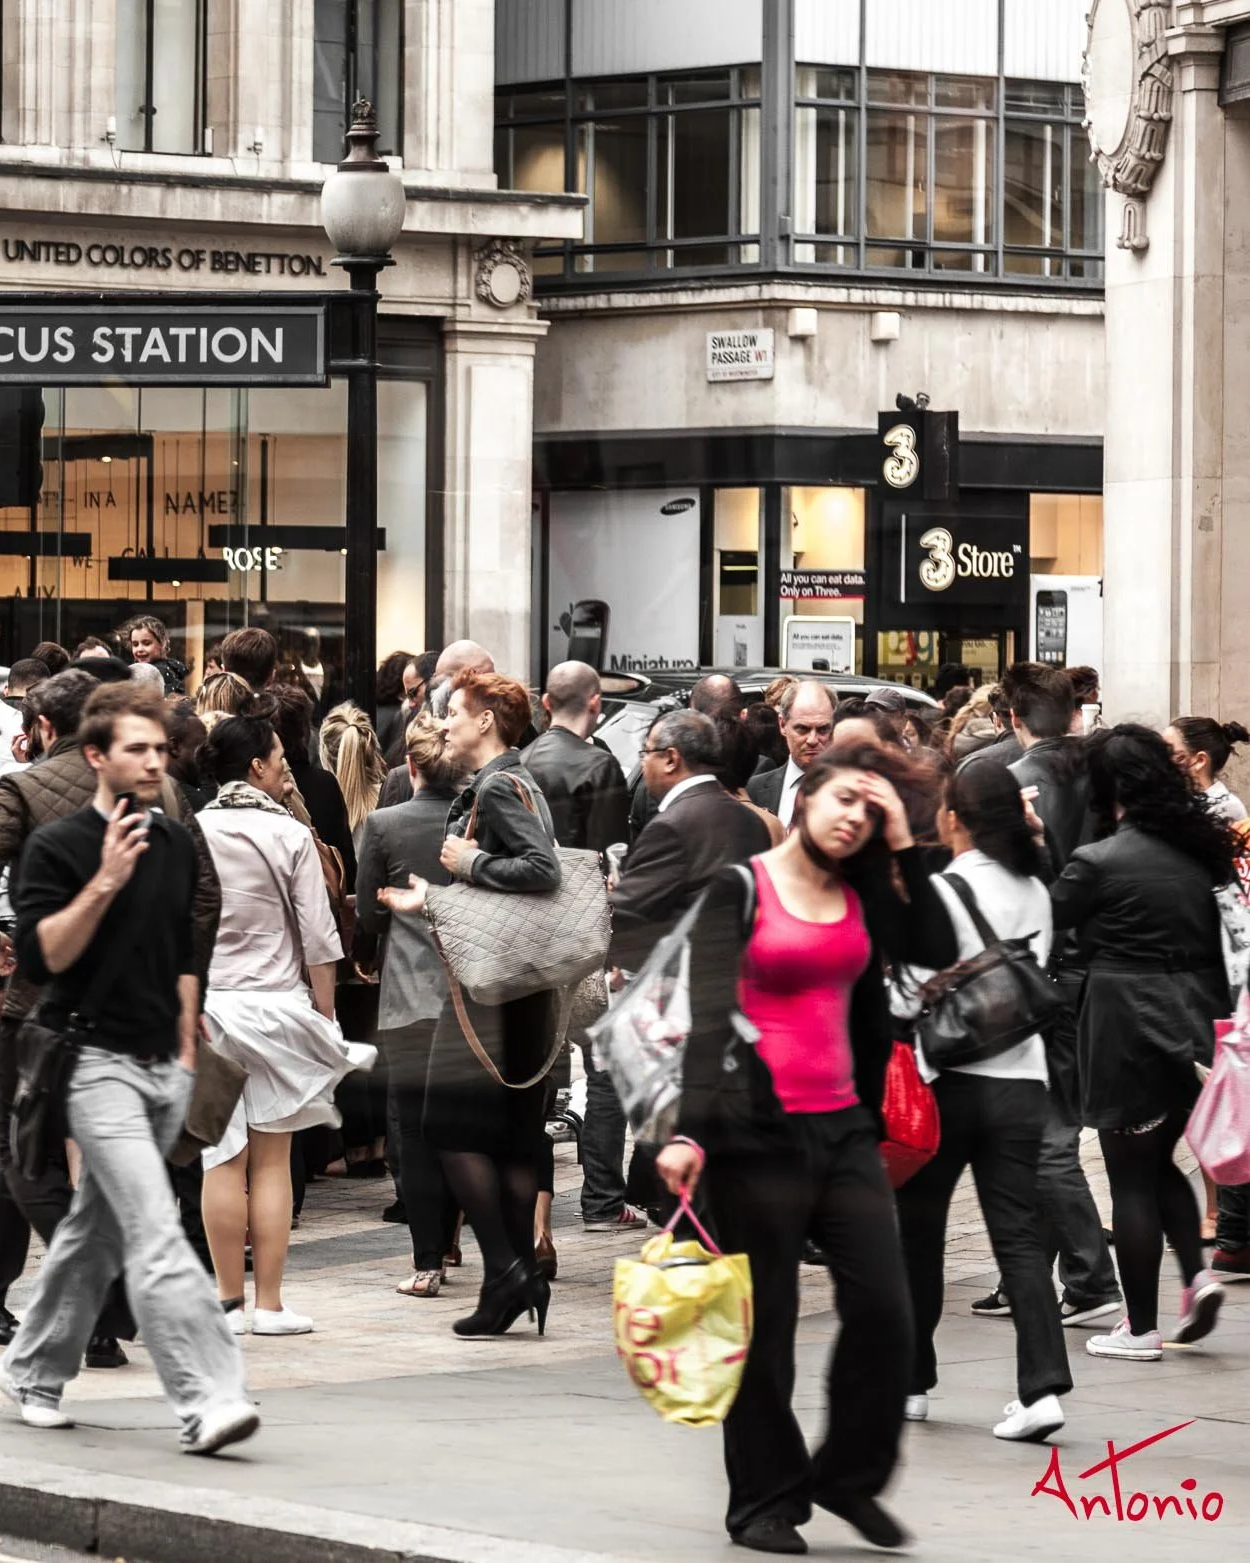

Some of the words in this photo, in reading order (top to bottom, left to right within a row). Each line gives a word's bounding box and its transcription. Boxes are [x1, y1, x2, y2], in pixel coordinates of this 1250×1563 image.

[2, 239, 82, 265] UNITED
[86, 243, 173, 270] COLORS
[177, 248, 207, 271] OF
[211, 250, 327, 276] BENETTON.
[91, 325, 284, 363] STATION
[711, 334, 758, 349] SWALLOW
[711, 350, 751, 365] PASSAGE
[754, 349, 768, 361] W1
[883, 423, 920, 488] 3
[919, 527, 956, 592] 3
[780, 573, 792, 584] All
[793, 574, 809, 586] you
[811, 575, 827, 584] can
[829, 574, 842, 585] eat
[843, 574, 866, 585] data.
[780, 585, 801, 599] Only
[802, 588, 813, 597] on
[814, 585, 842, 598] Three.
